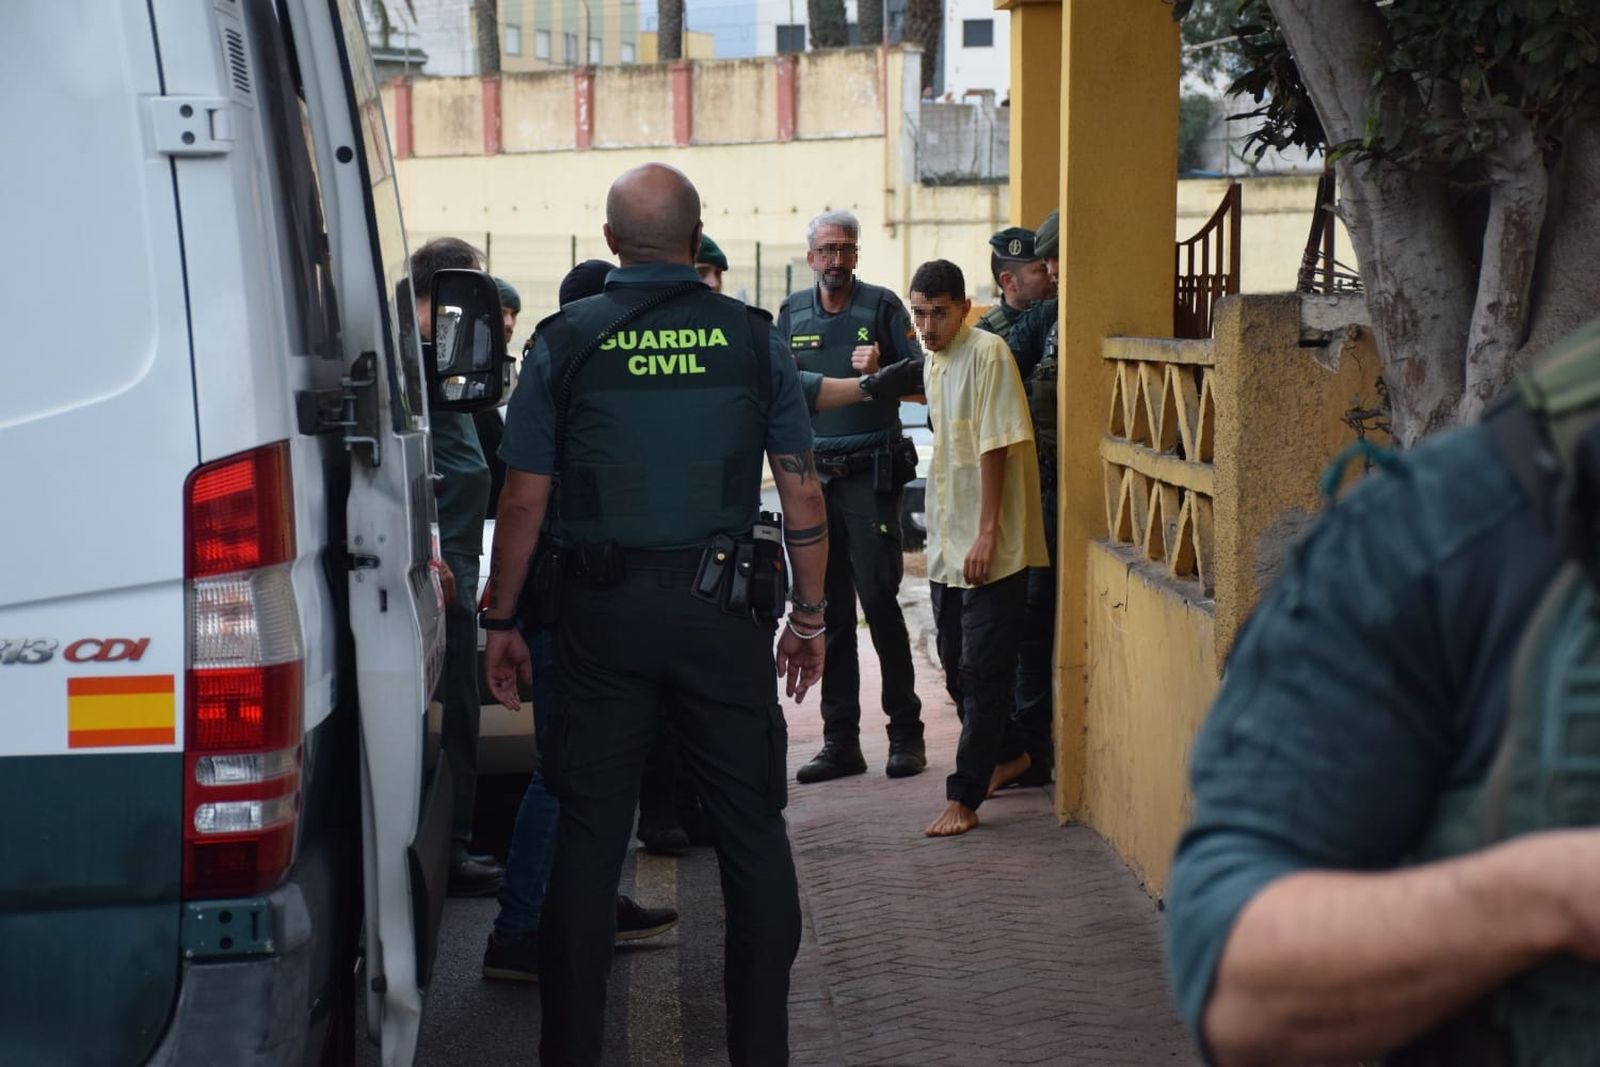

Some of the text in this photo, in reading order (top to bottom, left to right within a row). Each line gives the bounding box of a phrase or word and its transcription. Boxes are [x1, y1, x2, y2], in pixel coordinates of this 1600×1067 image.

[628, 354, 706, 375] CIVIL
[0, 638, 151, 665] 13 CDI
